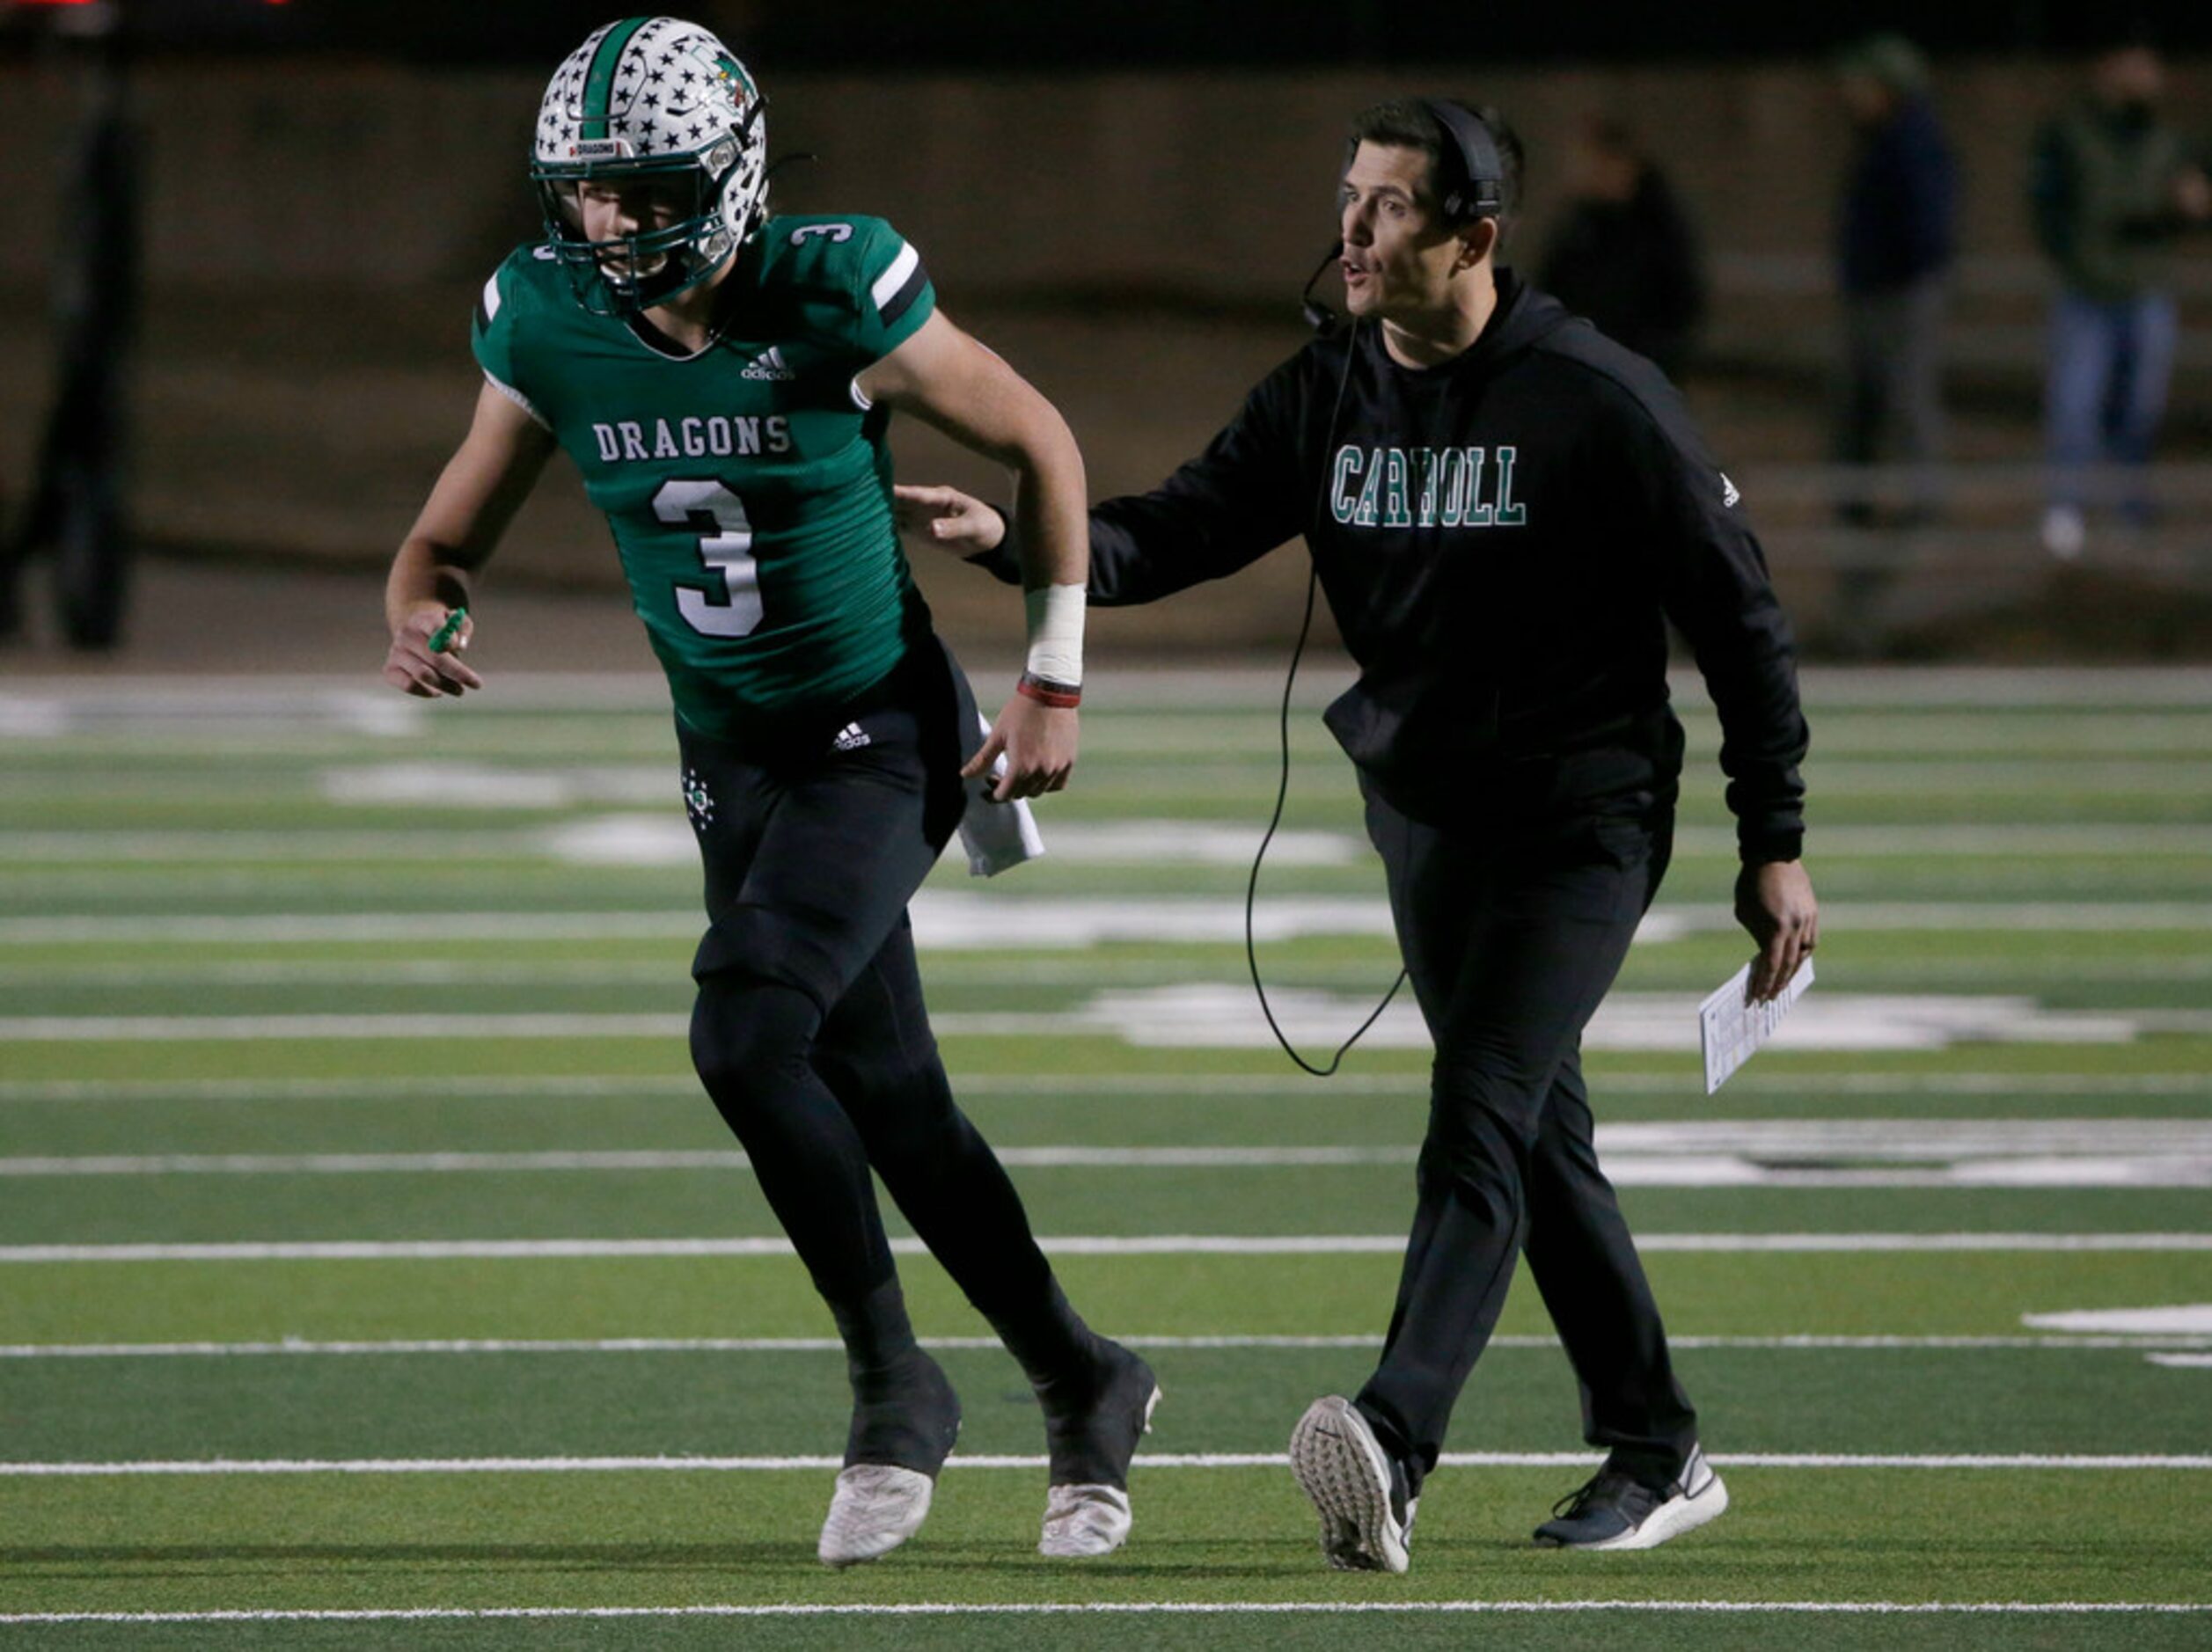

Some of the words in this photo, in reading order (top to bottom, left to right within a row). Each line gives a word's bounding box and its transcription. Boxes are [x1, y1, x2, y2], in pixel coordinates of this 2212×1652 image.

[576, 143, 615, 155] DRAGONS
[790, 223, 853, 246] 3
[592, 415, 790, 462] DRAGONS
[651, 479, 765, 638] 3
